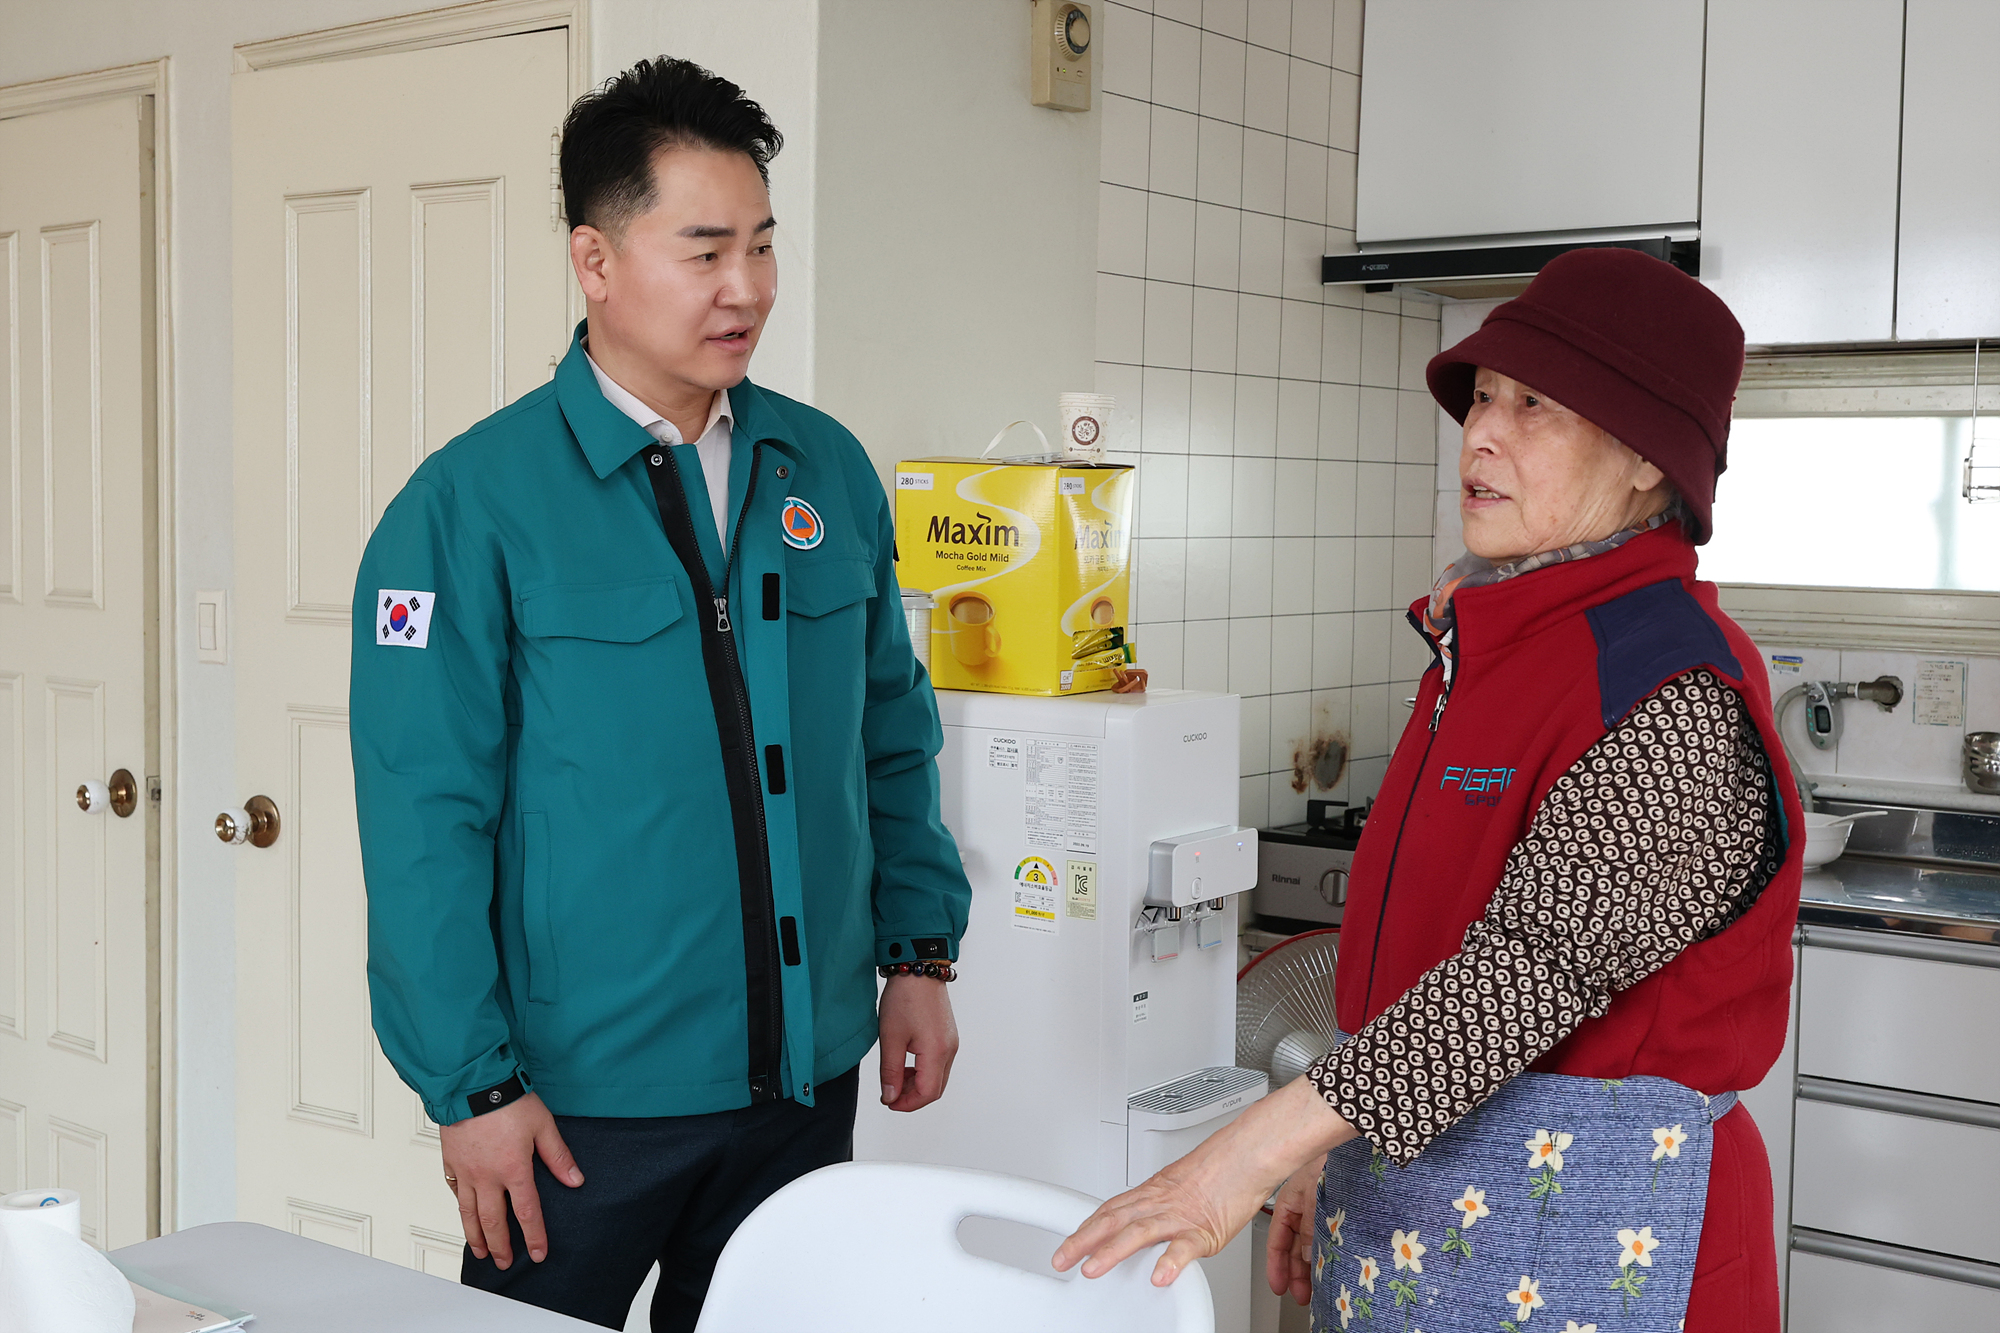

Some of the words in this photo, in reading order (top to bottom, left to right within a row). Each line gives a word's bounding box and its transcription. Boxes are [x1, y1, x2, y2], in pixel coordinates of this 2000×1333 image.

[1361, 263, 1390, 271] K-QUEEN
[900, 477, 914, 486] 280
[1063, 482, 1072, 490] 280
[926, 511, 1020, 547] Maxim
[936, 550, 964, 561] Mocha
[967, 551, 988, 562] Gold
[989, 552, 1009, 563] Mild
[956, 564, 975, 572] Coffee
[993, 737, 1016, 745] CUCKOO
[1183, 732, 1208, 743] CUCKOO
[1033, 873, 1039, 882] 3
[1272, 874, 1301, 885] Rinnai
